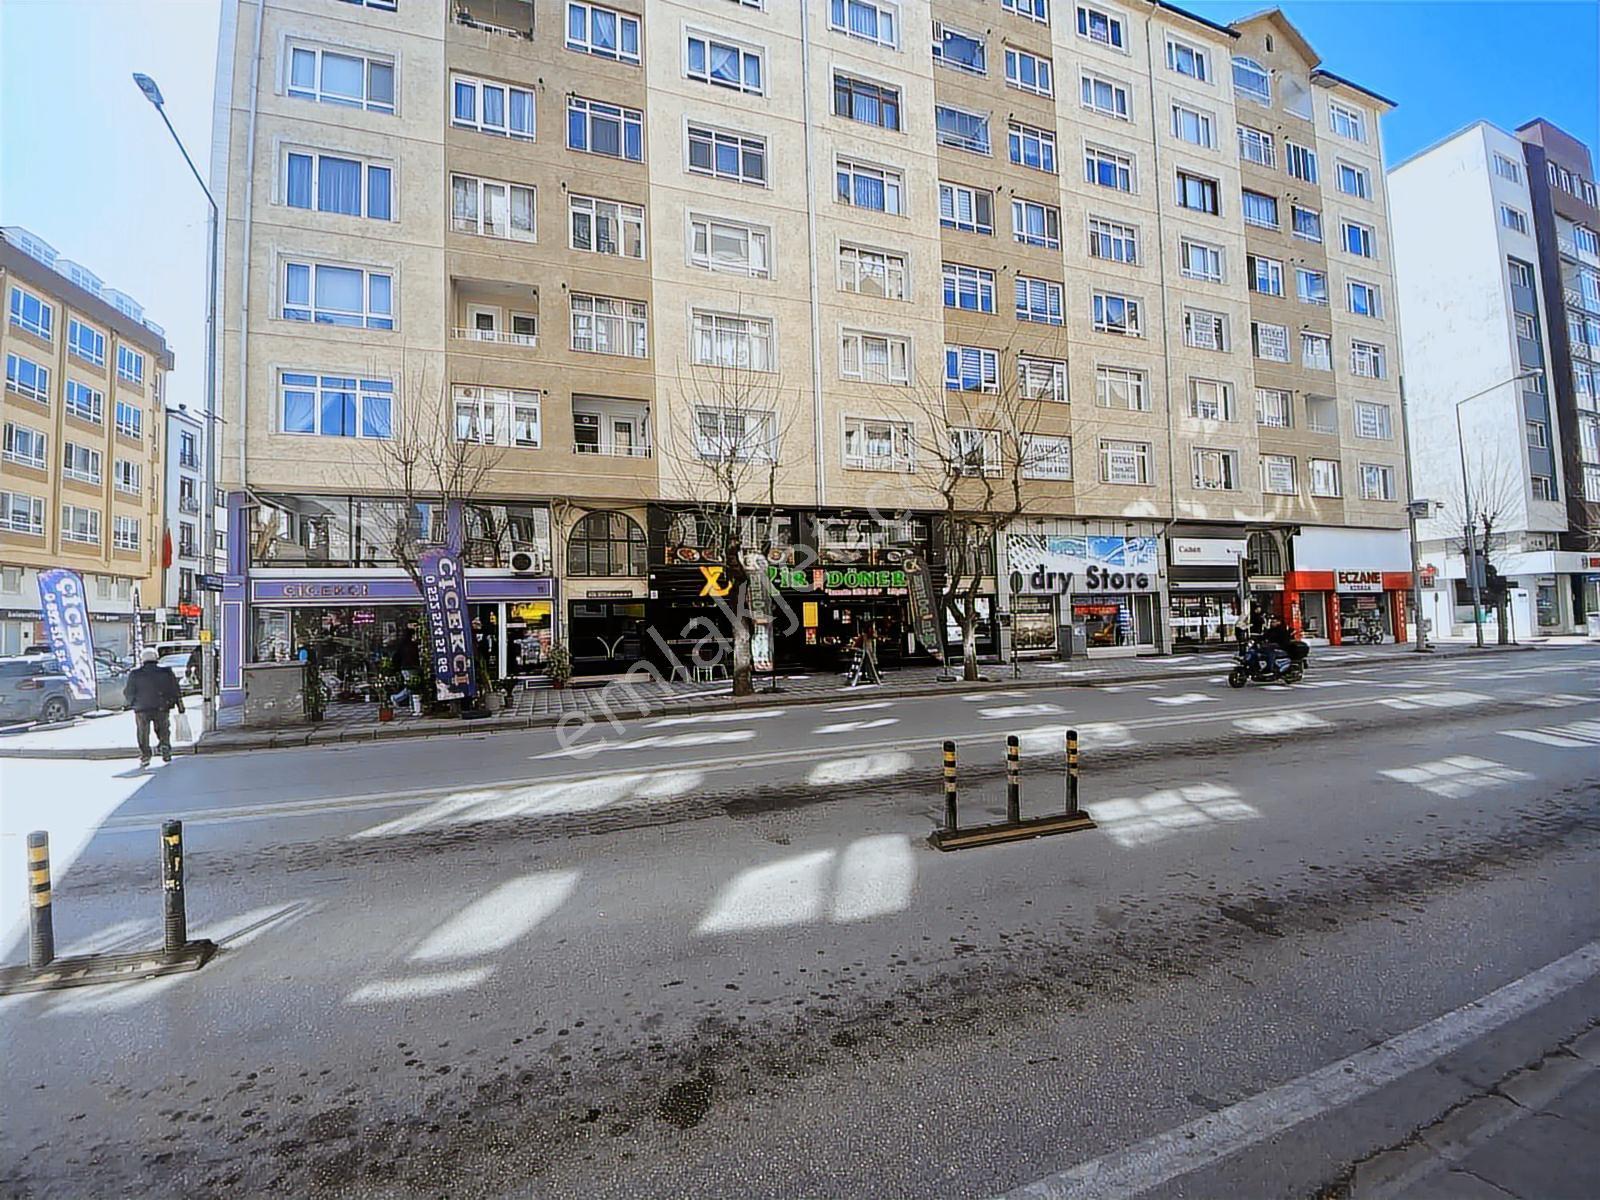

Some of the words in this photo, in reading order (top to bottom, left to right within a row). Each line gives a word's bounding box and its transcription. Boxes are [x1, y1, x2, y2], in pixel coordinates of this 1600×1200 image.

[826, 567, 908, 588] DÖNER
[1030, 564, 1074, 595] dry
[1086, 565, 1149, 589] Store
[1338, 571, 1381, 584] ECZANE
